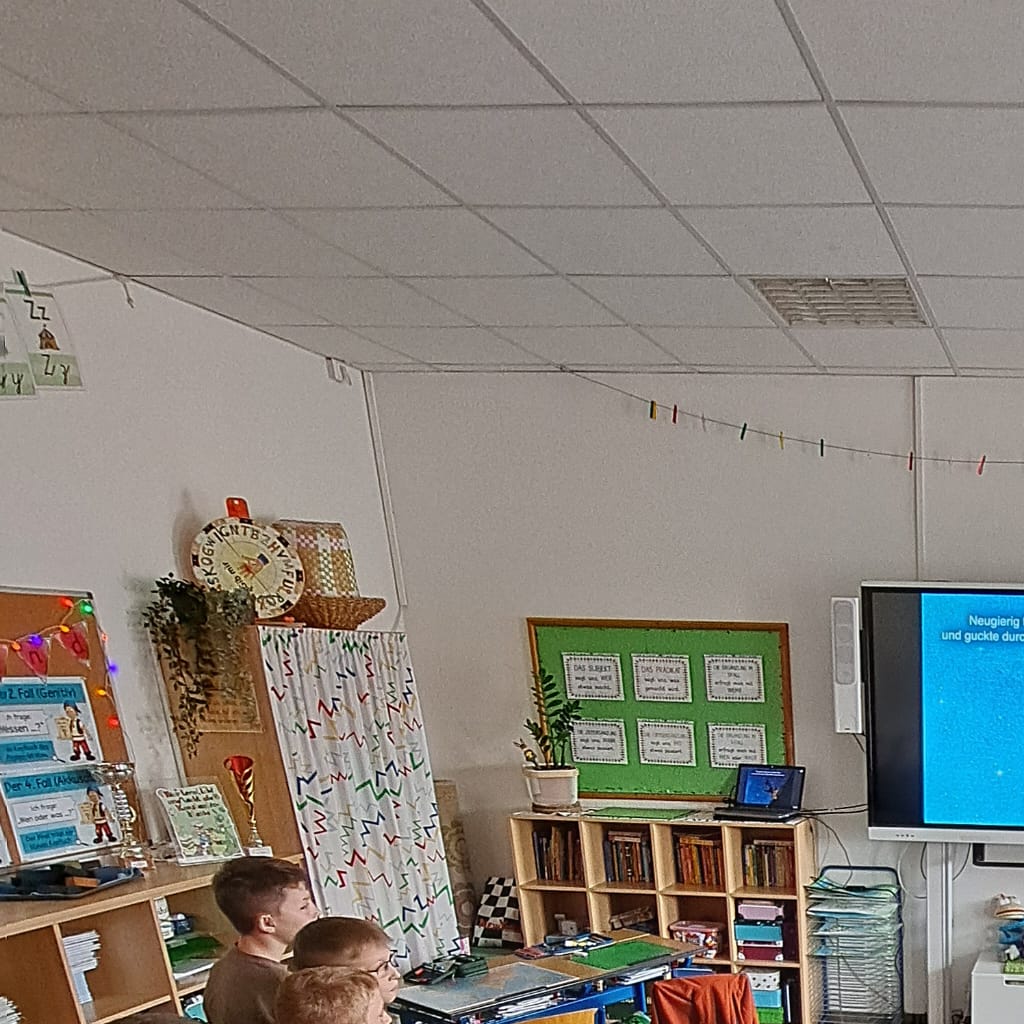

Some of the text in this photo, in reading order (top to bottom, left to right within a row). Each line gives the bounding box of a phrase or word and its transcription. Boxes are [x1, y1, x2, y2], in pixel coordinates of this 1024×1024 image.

[969, 615, 1020, 629] Neugierig
[941, 630, 962, 641] und
[964, 630, 999, 643] guckte
[18, 688, 35, 699] Fall
[4, 780, 23, 792] Der
[25, 780, 36, 791] 4.
[37, 778, 53, 789] Fall
